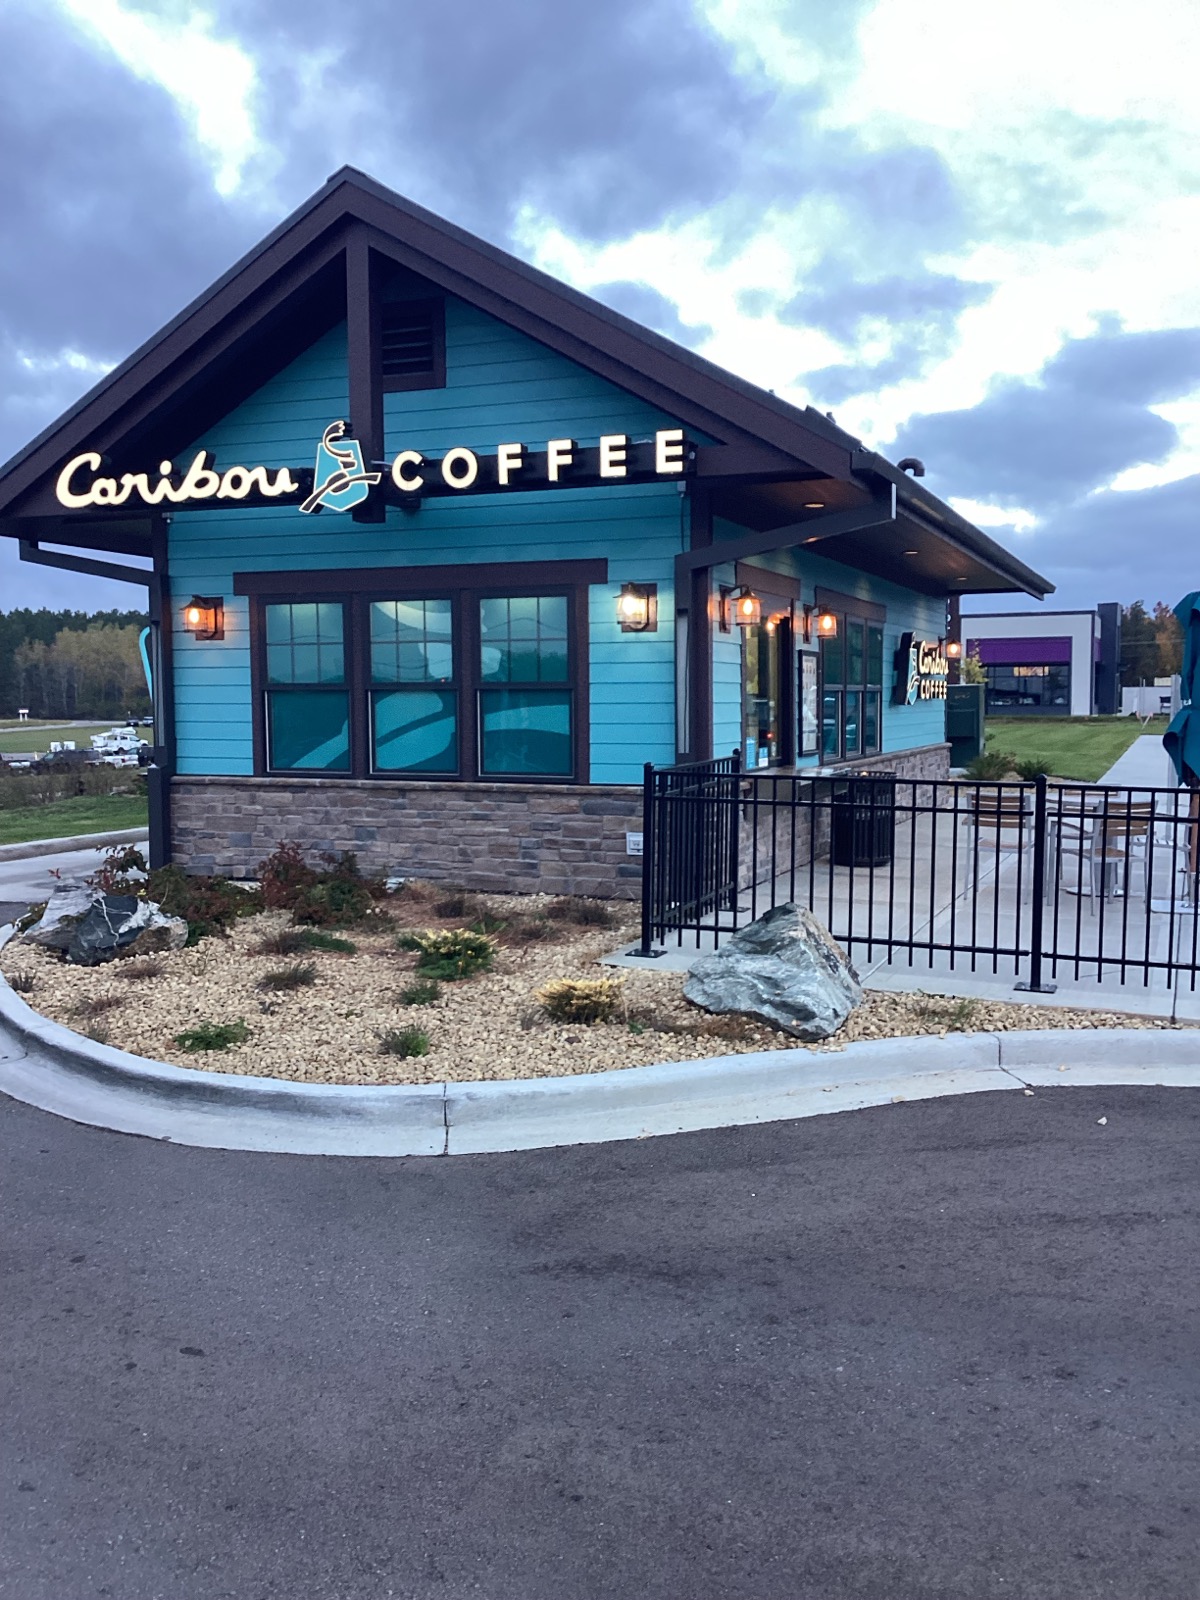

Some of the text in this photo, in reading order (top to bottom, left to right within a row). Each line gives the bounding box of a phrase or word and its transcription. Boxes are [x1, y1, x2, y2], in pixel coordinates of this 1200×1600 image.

[55, 429, 684, 509] Caribou COFFEE
[919, 640, 949, 675] Caribou
[920, 679, 947, 700] COFFEE
